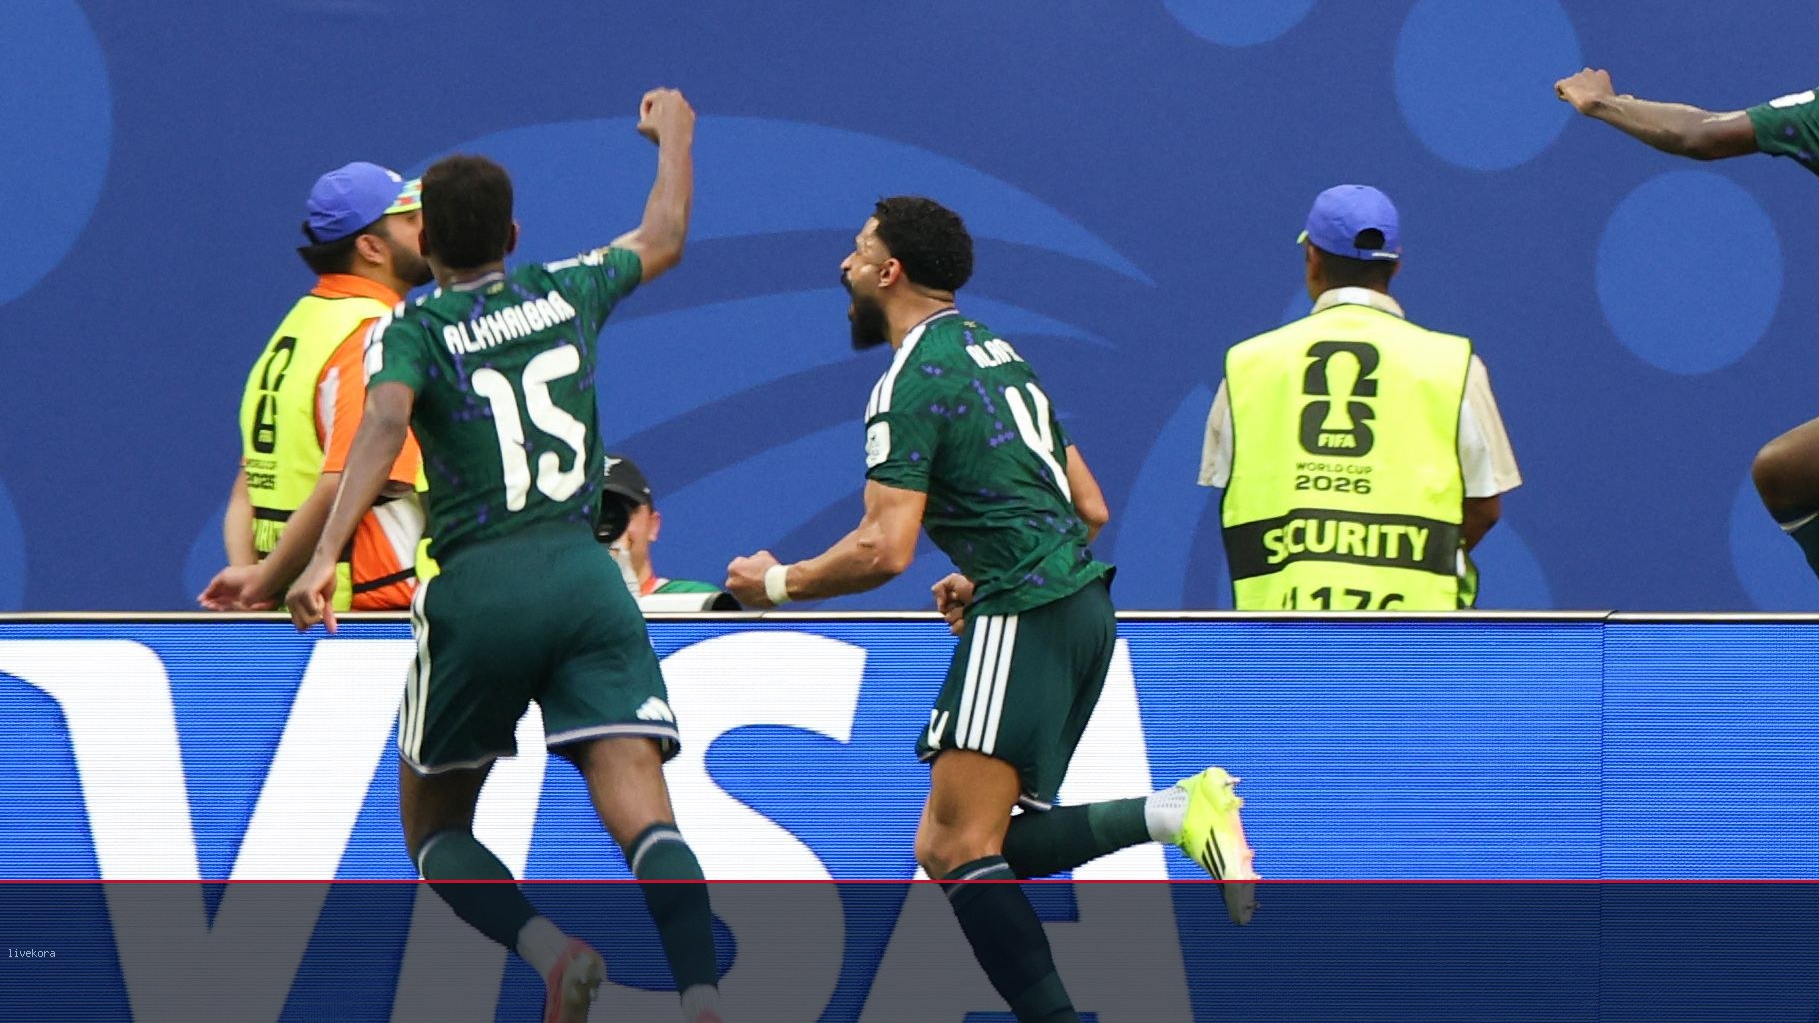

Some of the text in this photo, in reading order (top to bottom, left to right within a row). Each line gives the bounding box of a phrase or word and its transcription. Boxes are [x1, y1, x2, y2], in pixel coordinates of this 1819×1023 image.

[471, 343, 586, 512] 15
[1317, 433, 1357, 448] FIFA
[1296, 461, 1373, 474] WORLD CUP
[1295, 475, 1372, 495] 2026
[1263, 518, 1429, 565] SCURITY
